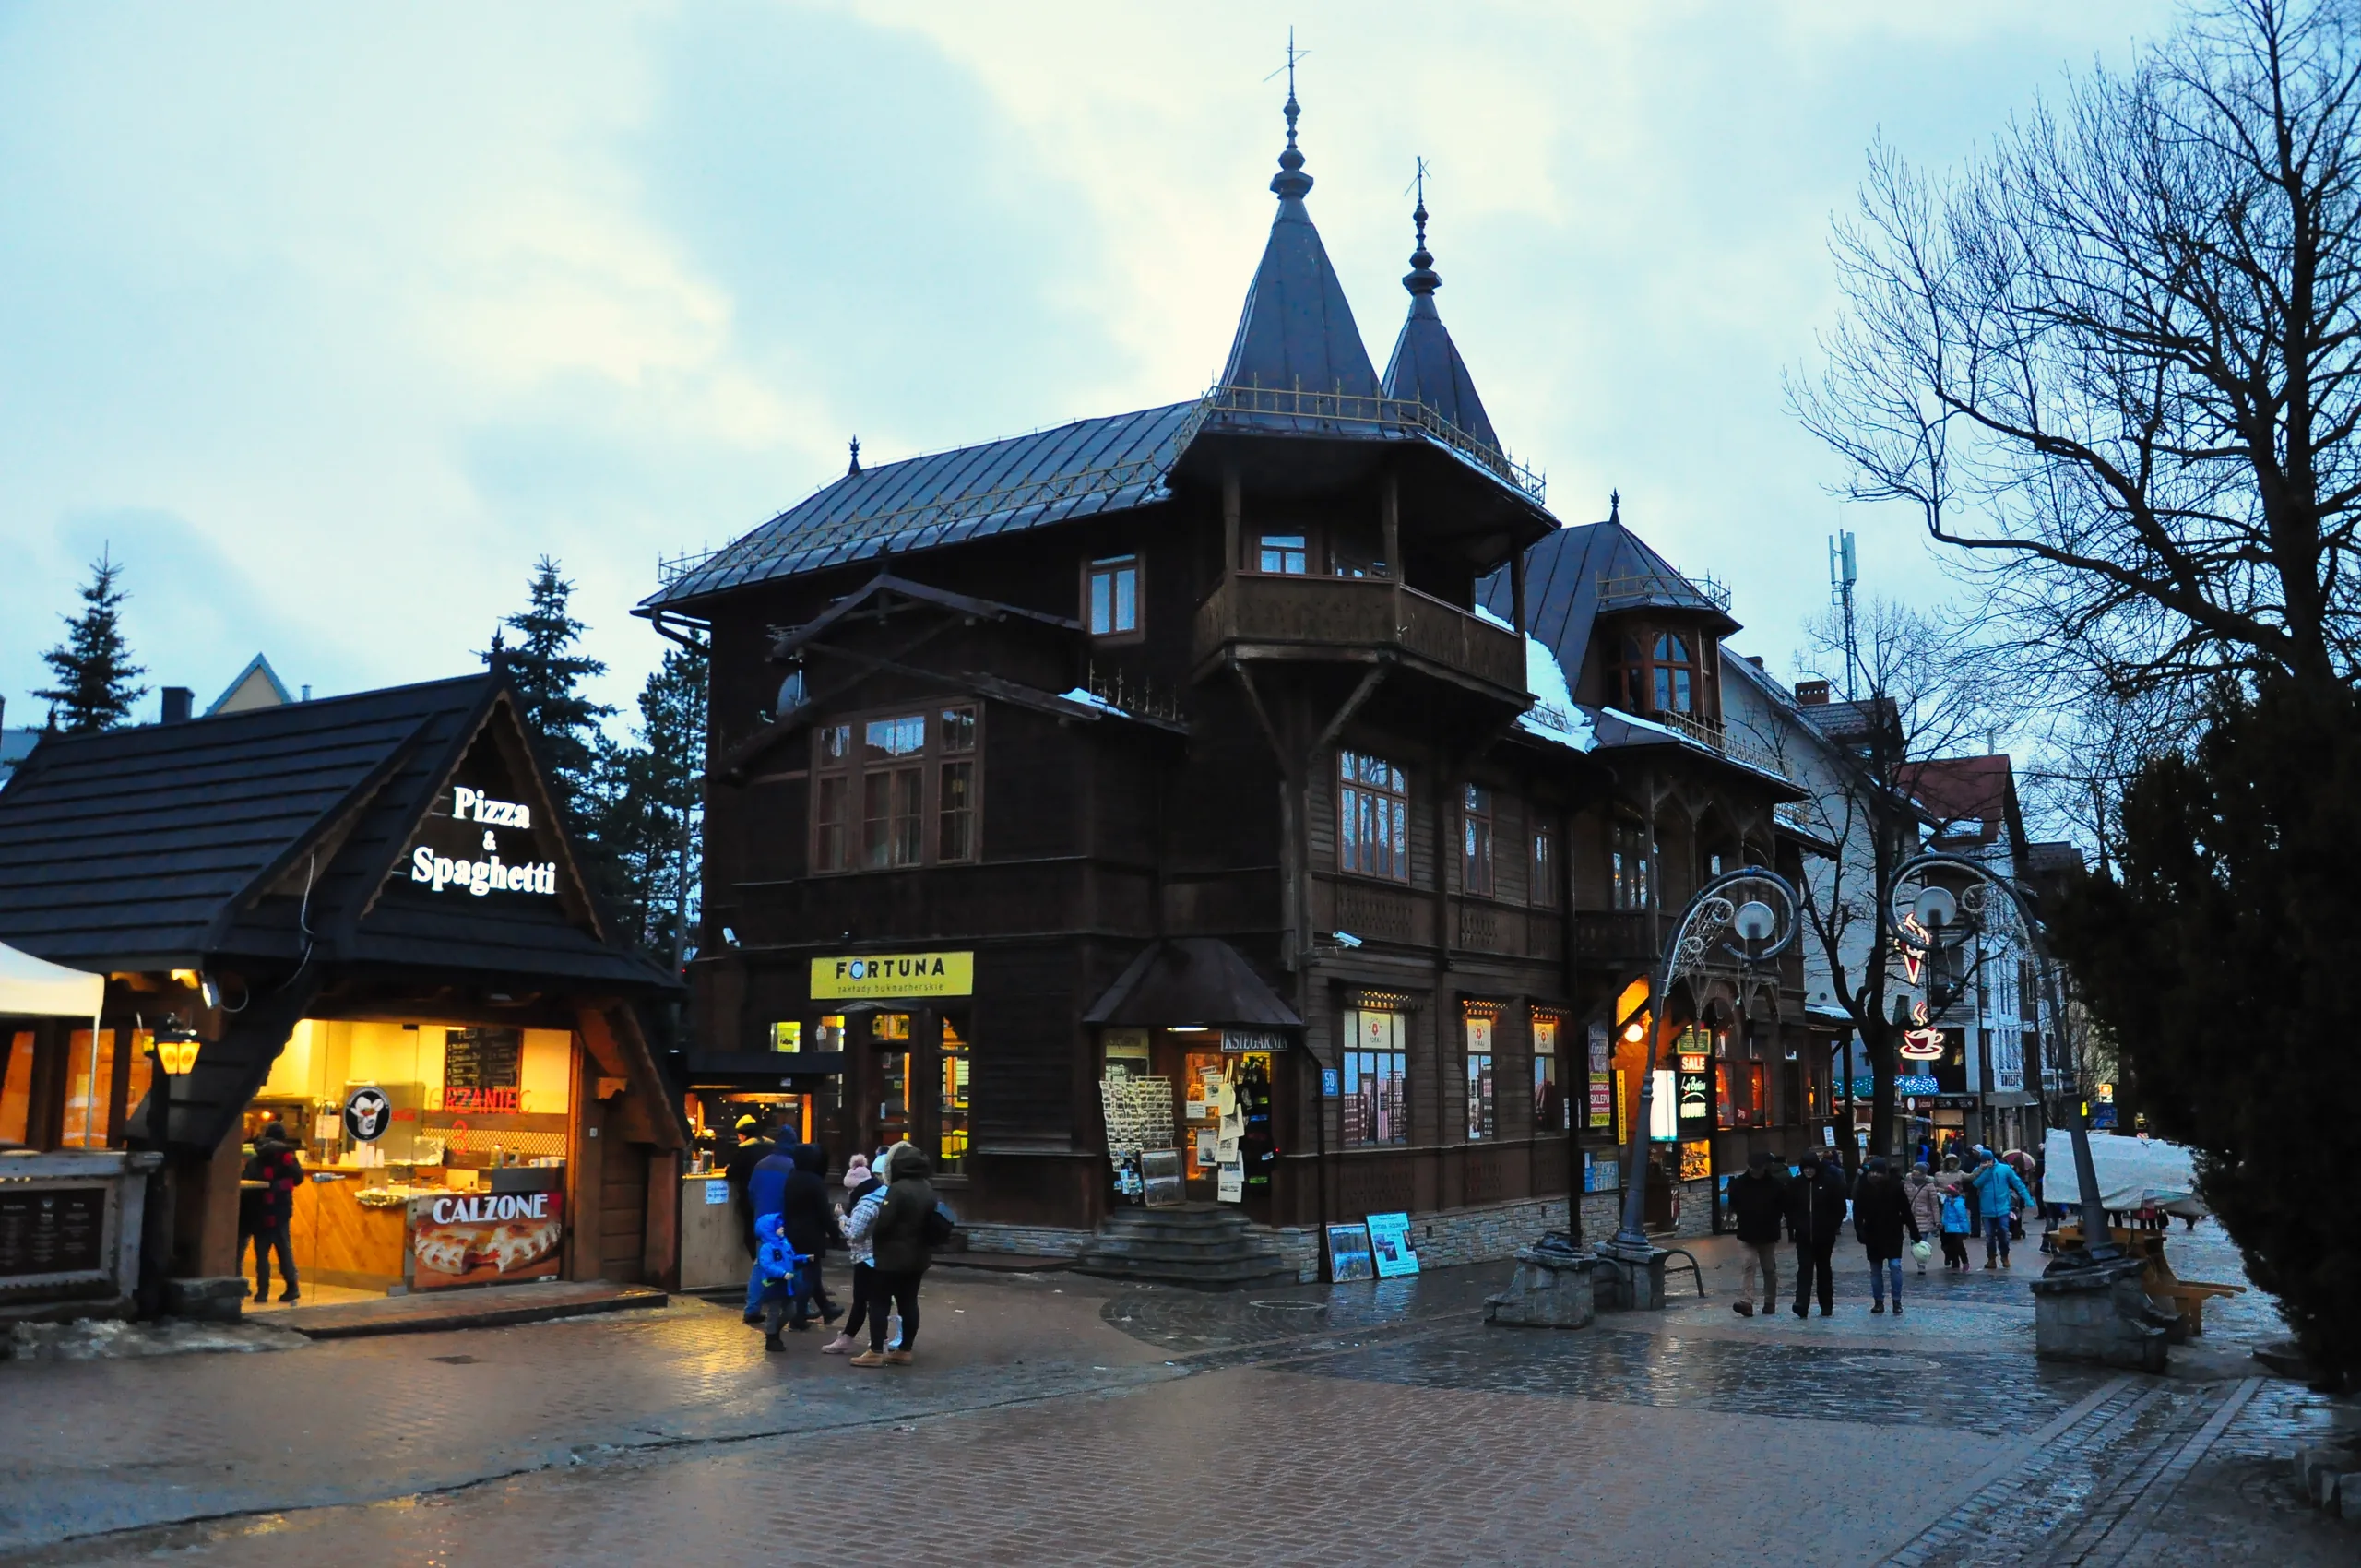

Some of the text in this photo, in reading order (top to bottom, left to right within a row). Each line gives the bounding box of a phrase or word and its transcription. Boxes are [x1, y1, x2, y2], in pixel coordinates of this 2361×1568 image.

[452, 787, 530, 828] Pizza
[482, 830, 496, 850] &
[412, 847, 555, 896] Spaghetti
[836, 957, 944, 980] FORTUNA
[1681, 1056, 1705, 1071] SALE
[1324, 1072, 1335, 1087] 50
[429, 1087, 531, 1114] GRZANIEC
[1590, 1094, 1610, 1105] SKLEPU
[452, 1119, 468, 1155] 3
[433, 1194, 548, 1225] CALZONE
